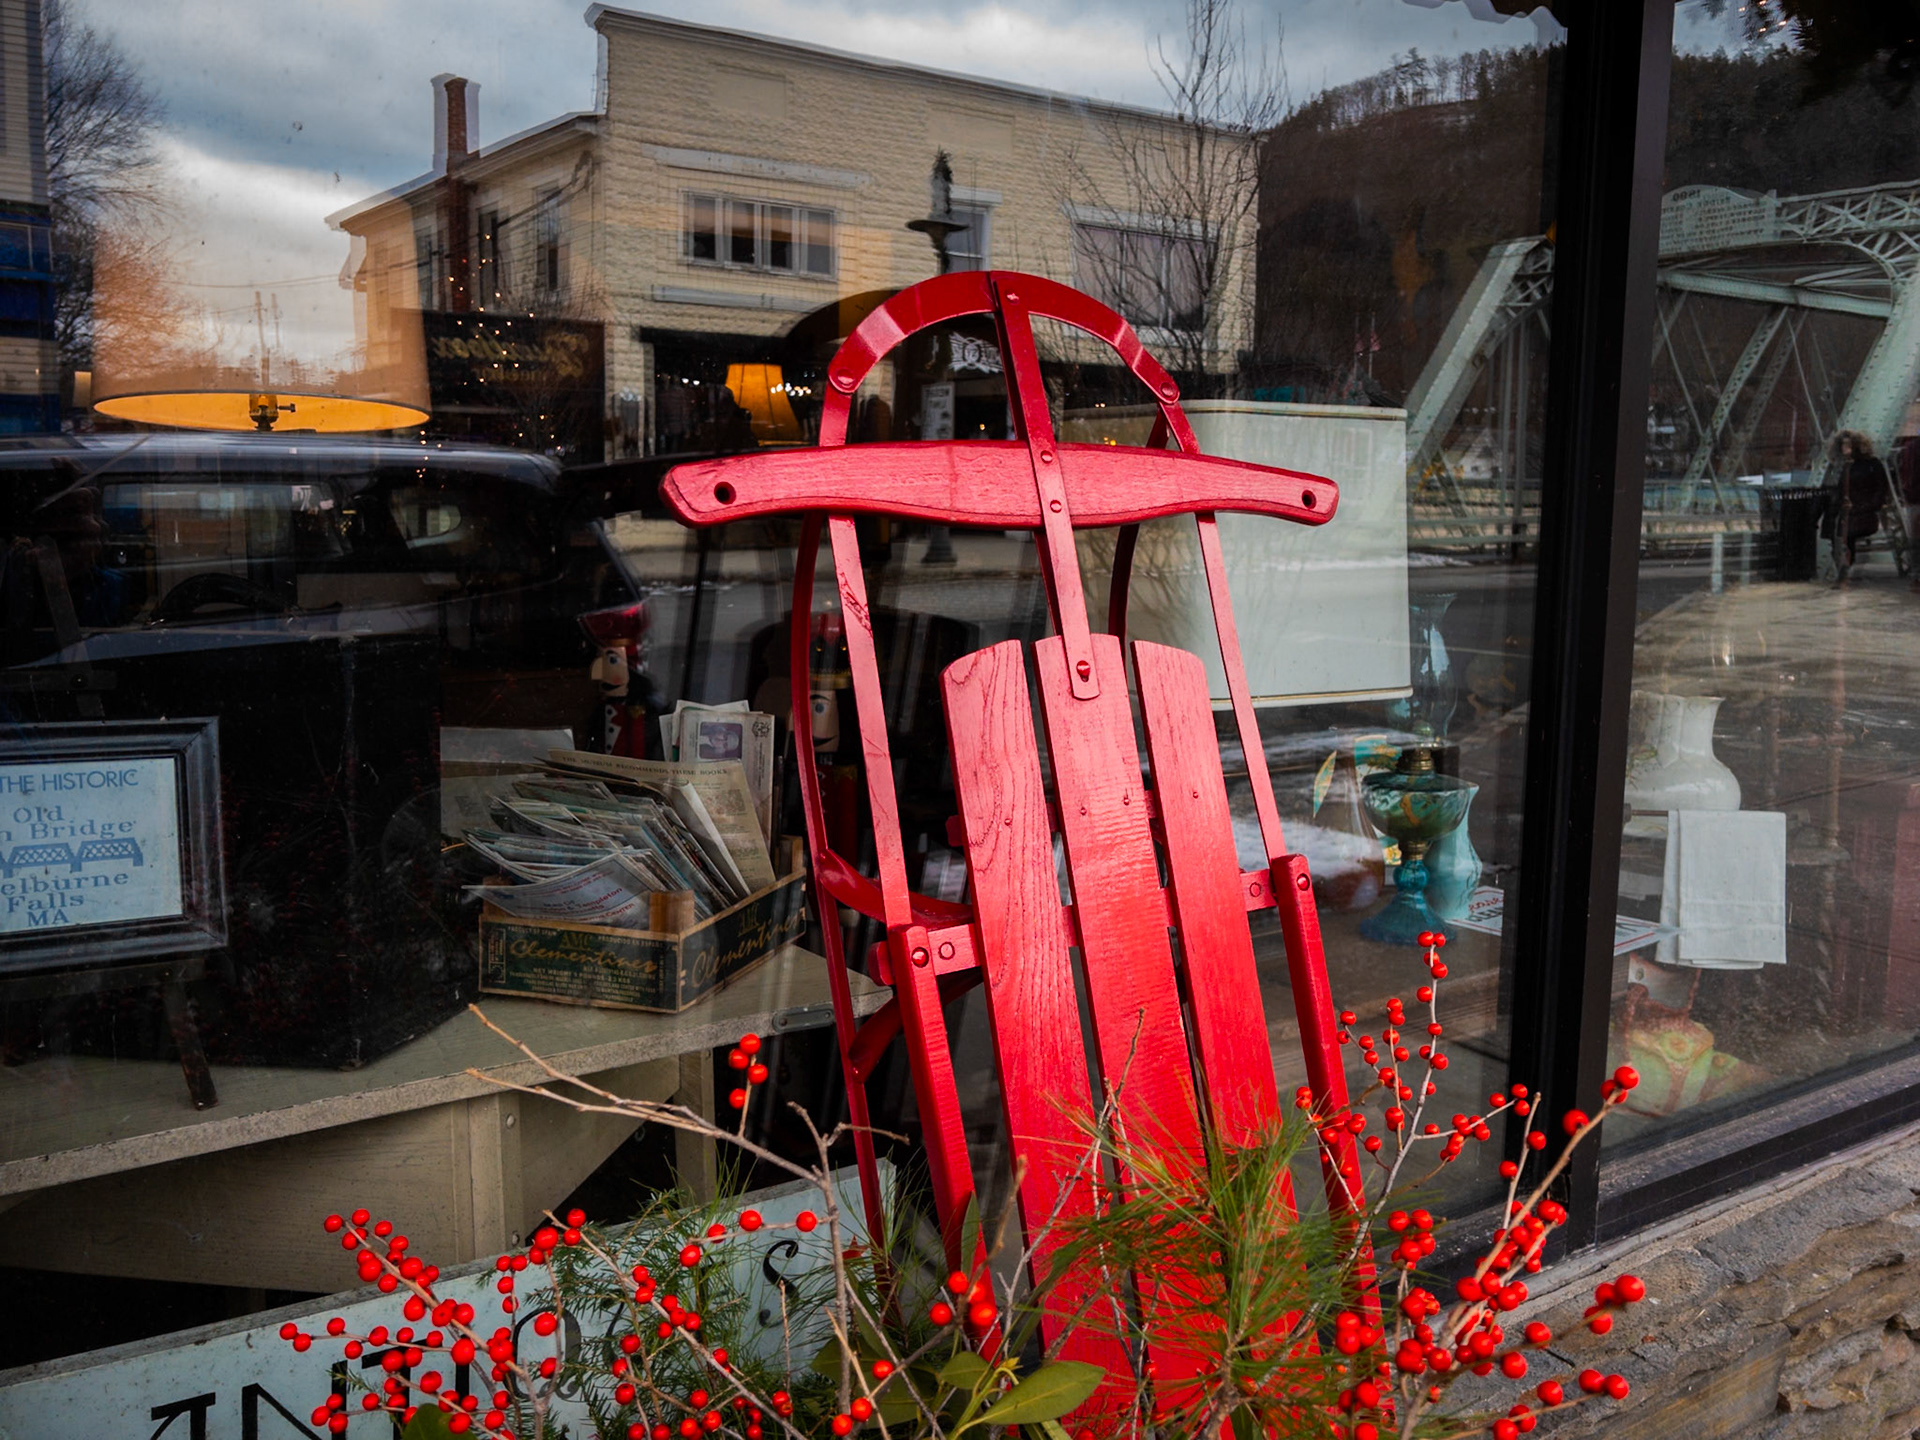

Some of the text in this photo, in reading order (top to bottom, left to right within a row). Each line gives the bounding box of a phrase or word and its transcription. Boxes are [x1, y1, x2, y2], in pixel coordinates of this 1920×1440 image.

[616, 763, 669, 775] RECOMMENDS
[0, 769, 139, 793] THE HISTORIC
[14, 805, 64, 824] Old
[30, 819, 134, 840] Bridge
[8, 893, 84, 913] Falls
[27, 908, 70, 927] MA
[510, 938, 658, 973] Clementines
